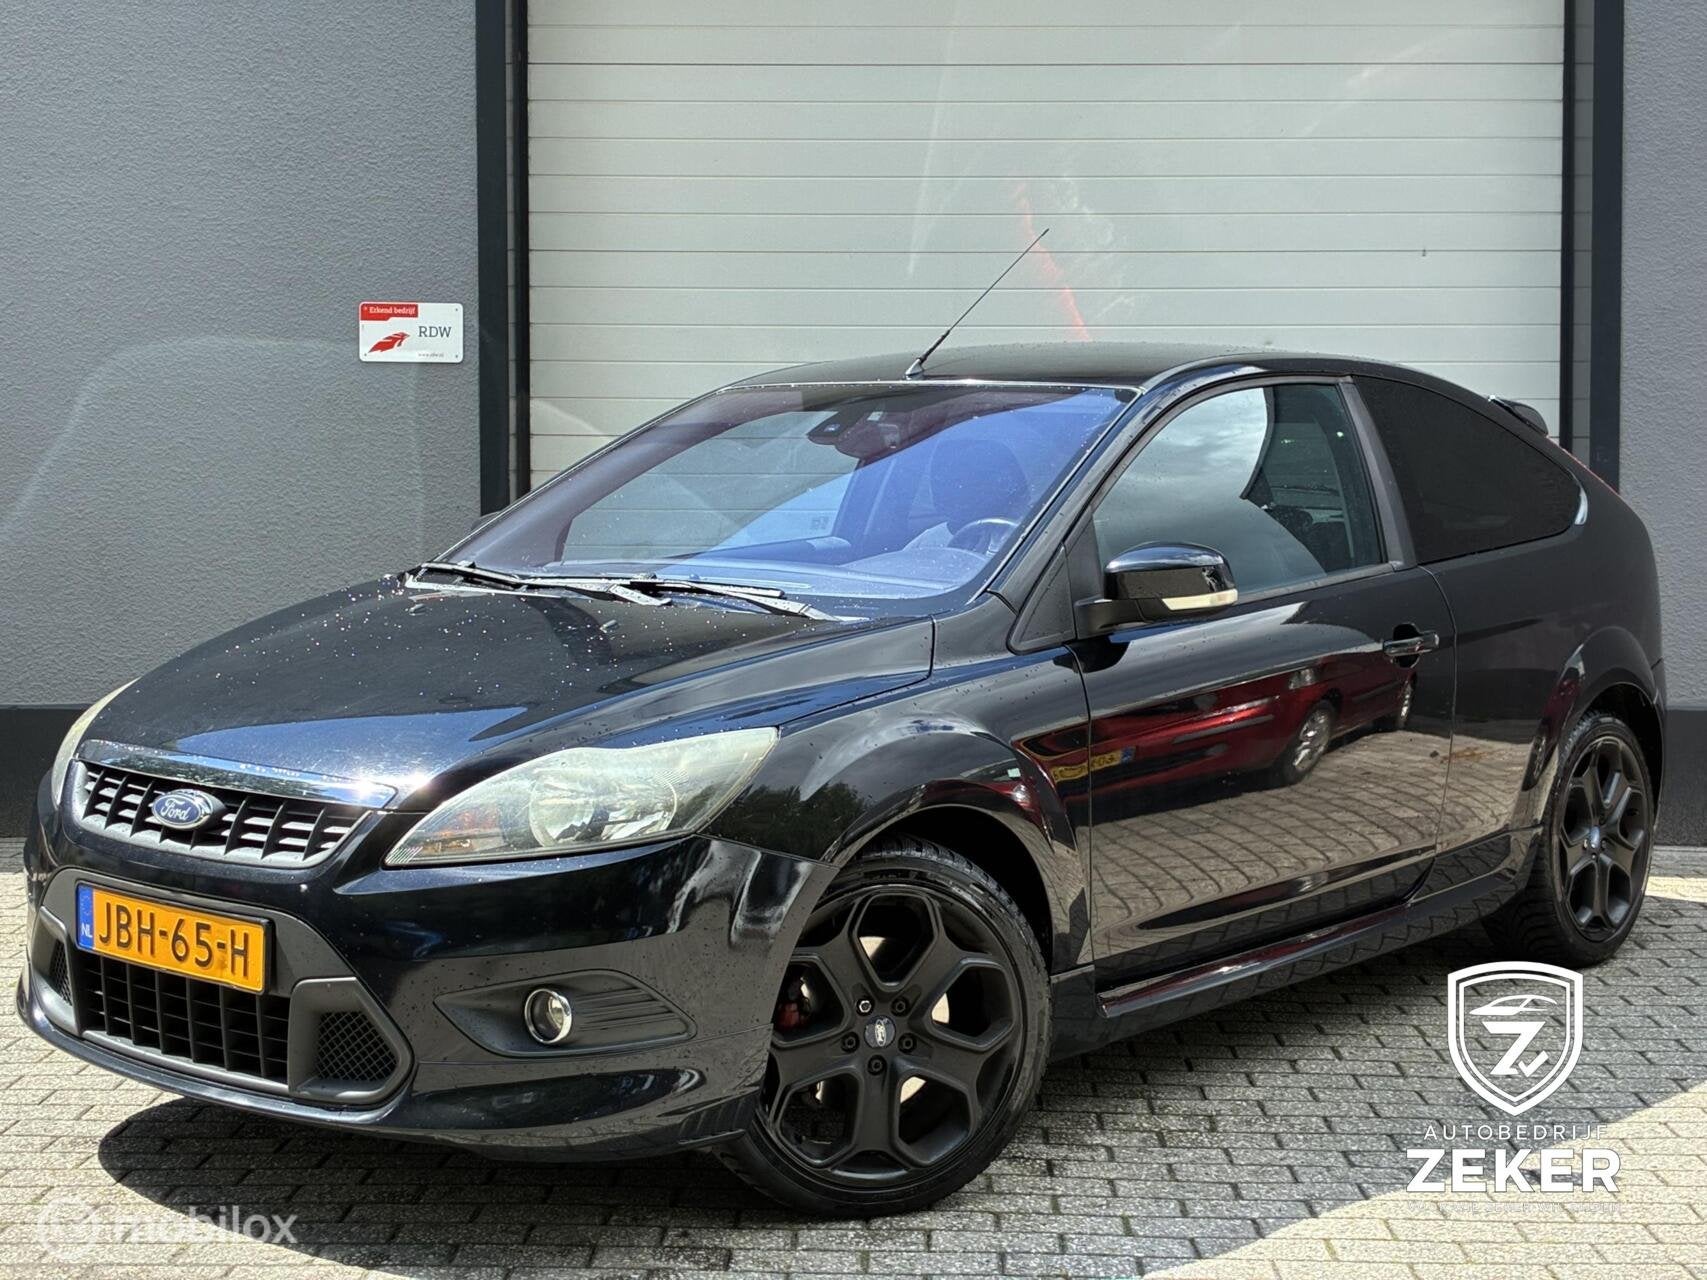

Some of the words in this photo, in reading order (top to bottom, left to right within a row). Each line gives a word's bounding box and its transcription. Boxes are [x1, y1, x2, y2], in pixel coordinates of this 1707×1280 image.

[369, 306, 392, 314] Erkend
[418, 326, 452, 338] RDW
[160, 798, 192, 820] Ford
[81, 922, 93, 938] NL
[98, 902, 249, 978] JBH-65-H
